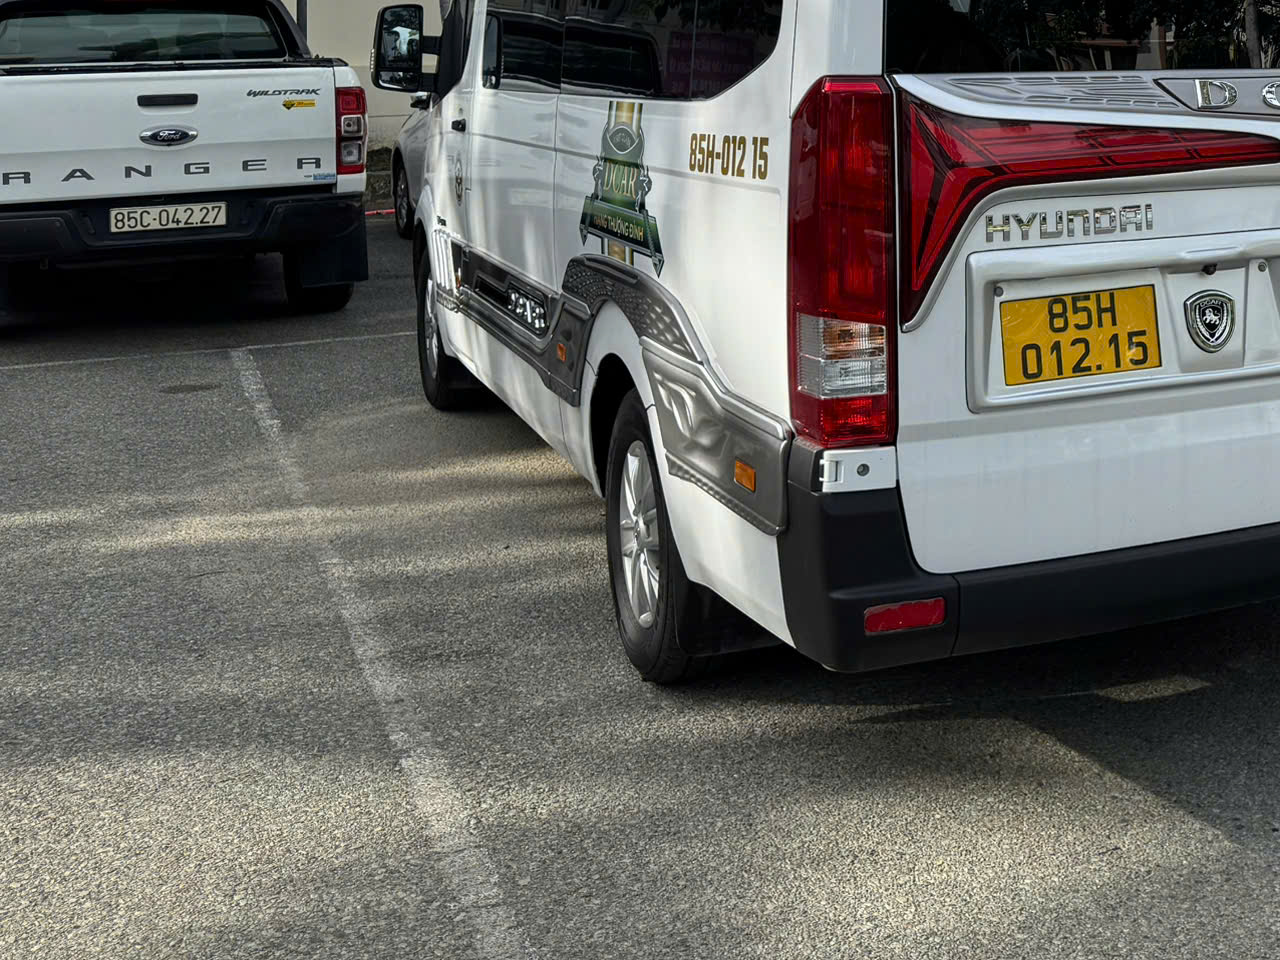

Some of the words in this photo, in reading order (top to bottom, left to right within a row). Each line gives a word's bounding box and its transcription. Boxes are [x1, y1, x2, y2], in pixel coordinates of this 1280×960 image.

[246, 88, 322, 98] WILDTRAK
[157, 129, 182, 142] Ford
[2, 157, 322, 186] RANGER
[603, 159, 639, 201] DCAR
[114, 205, 223, 231] 85C-042.27
[984, 202, 1154, 243] HYUNDAI
[1046, 290, 1118, 334] 85H
[1020, 325, 1151, 381] 012.15
